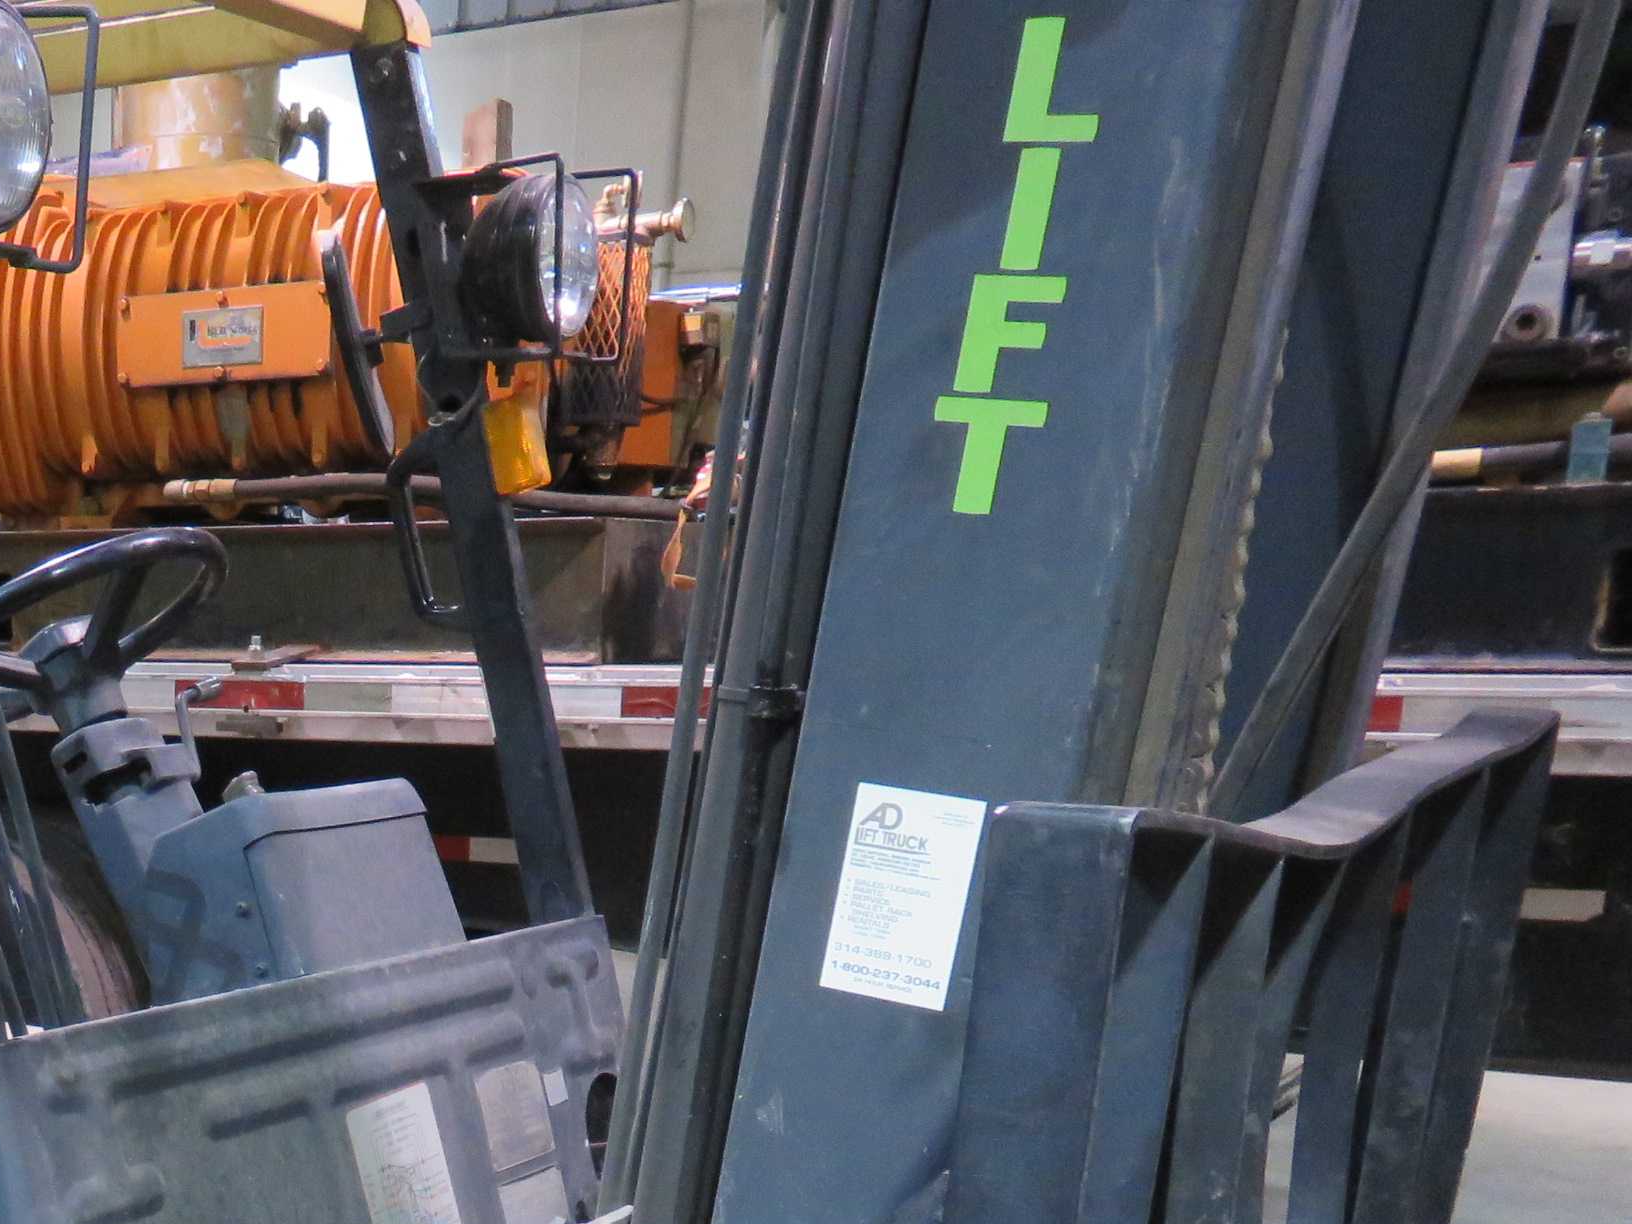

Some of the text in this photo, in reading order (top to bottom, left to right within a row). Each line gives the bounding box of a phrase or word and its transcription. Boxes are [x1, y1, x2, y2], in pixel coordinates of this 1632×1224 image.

[934, 16, 1099, 515] LIFT
[859, 802, 903, 830] AD
[882, 831, 929, 851] TRUCK
[832, 960, 941, 990] 1-800-237-3044
